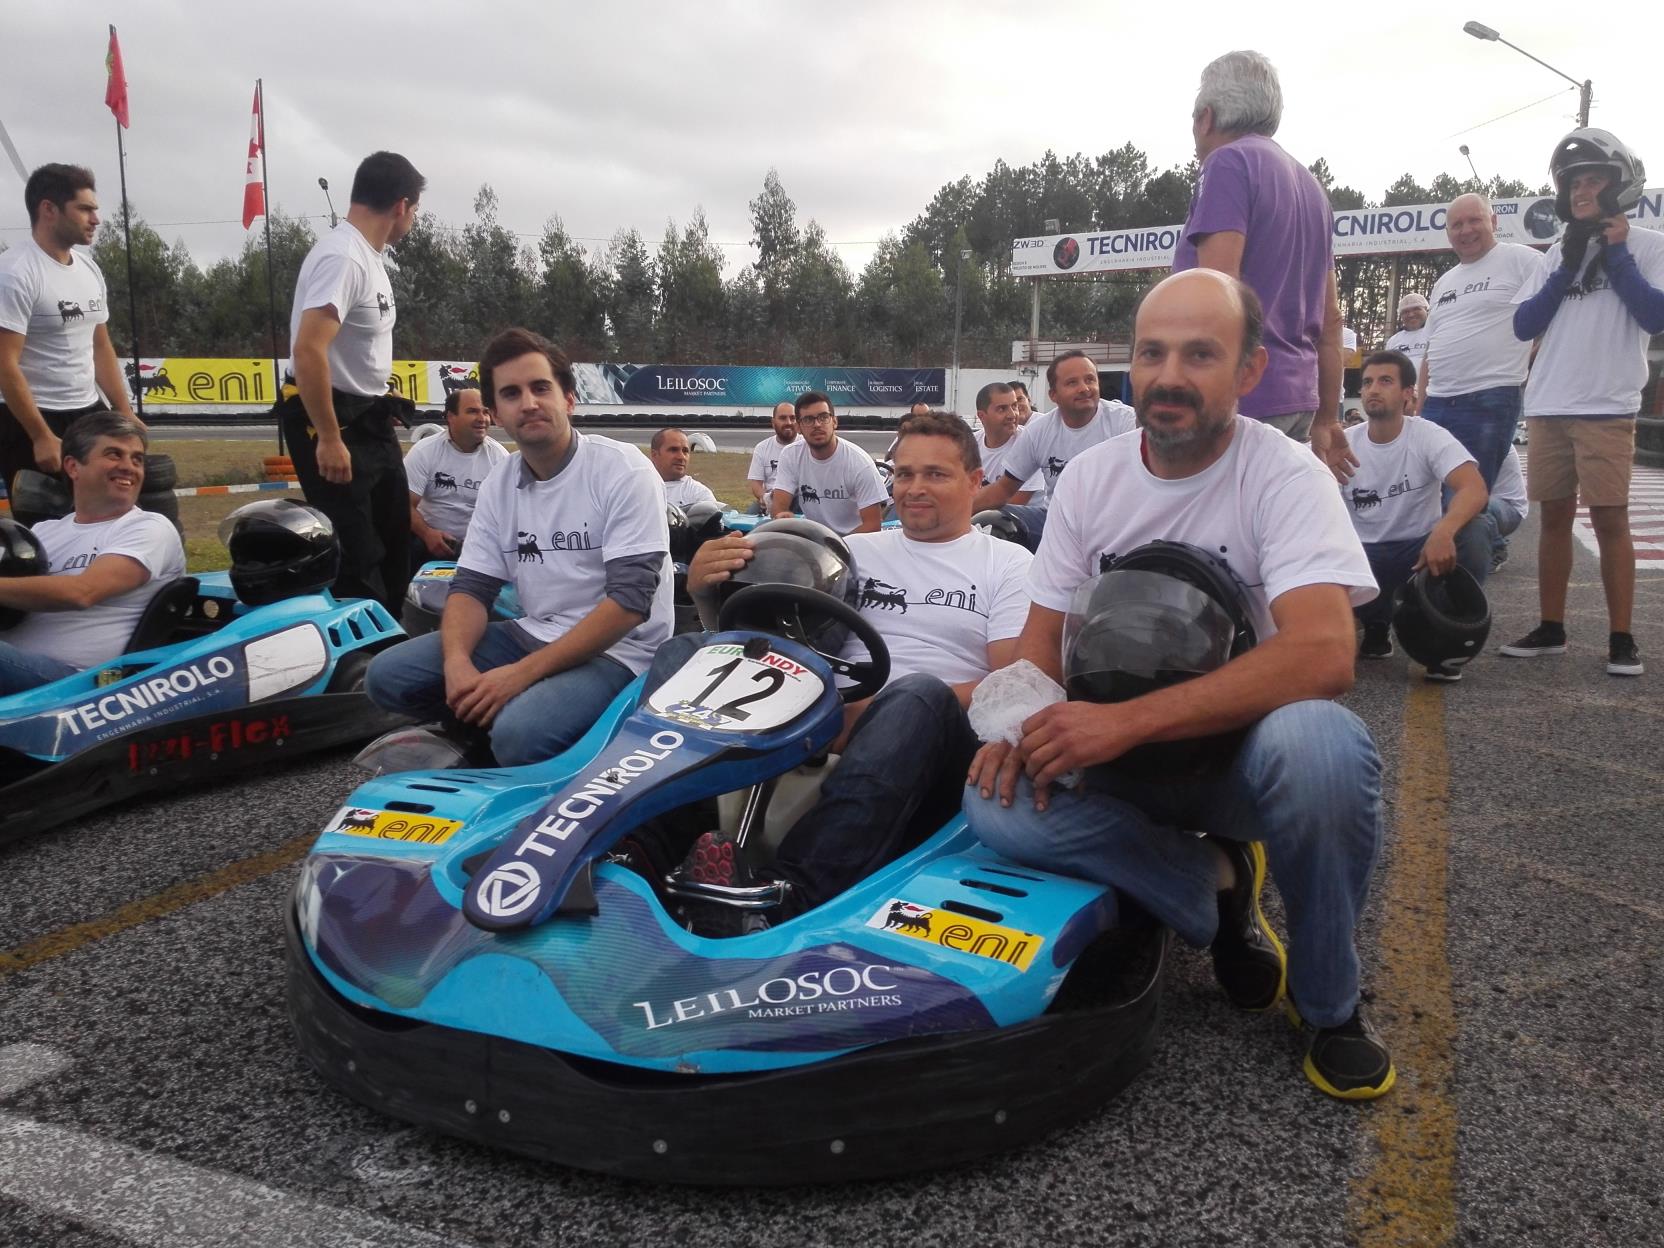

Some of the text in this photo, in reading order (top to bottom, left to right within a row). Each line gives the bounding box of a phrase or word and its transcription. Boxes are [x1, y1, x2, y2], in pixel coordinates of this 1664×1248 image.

[1333, 208, 1448, 237] CNIROLO
[1087, 230, 1181, 255] TECNIRO
[1464, 277, 1491, 294] eni
[188, 361, 263, 401] eni
[656, 375, 726, 390] LEILOSOC
[823, 485, 845, 499] eni
[551, 522, 591, 550] eni
[925, 584, 977, 612] eni
[62, 656, 235, 735] TECNIROLO
[689, 658, 786, 722] 12
[515, 731, 684, 859] TECNIROLO
[379, 819, 457, 845] eni
[939, 924, 1034, 966] eni
[632, 965, 898, 1031] LEILOSOC
[748, 994, 902, 1019] MARKET PARTNERS
